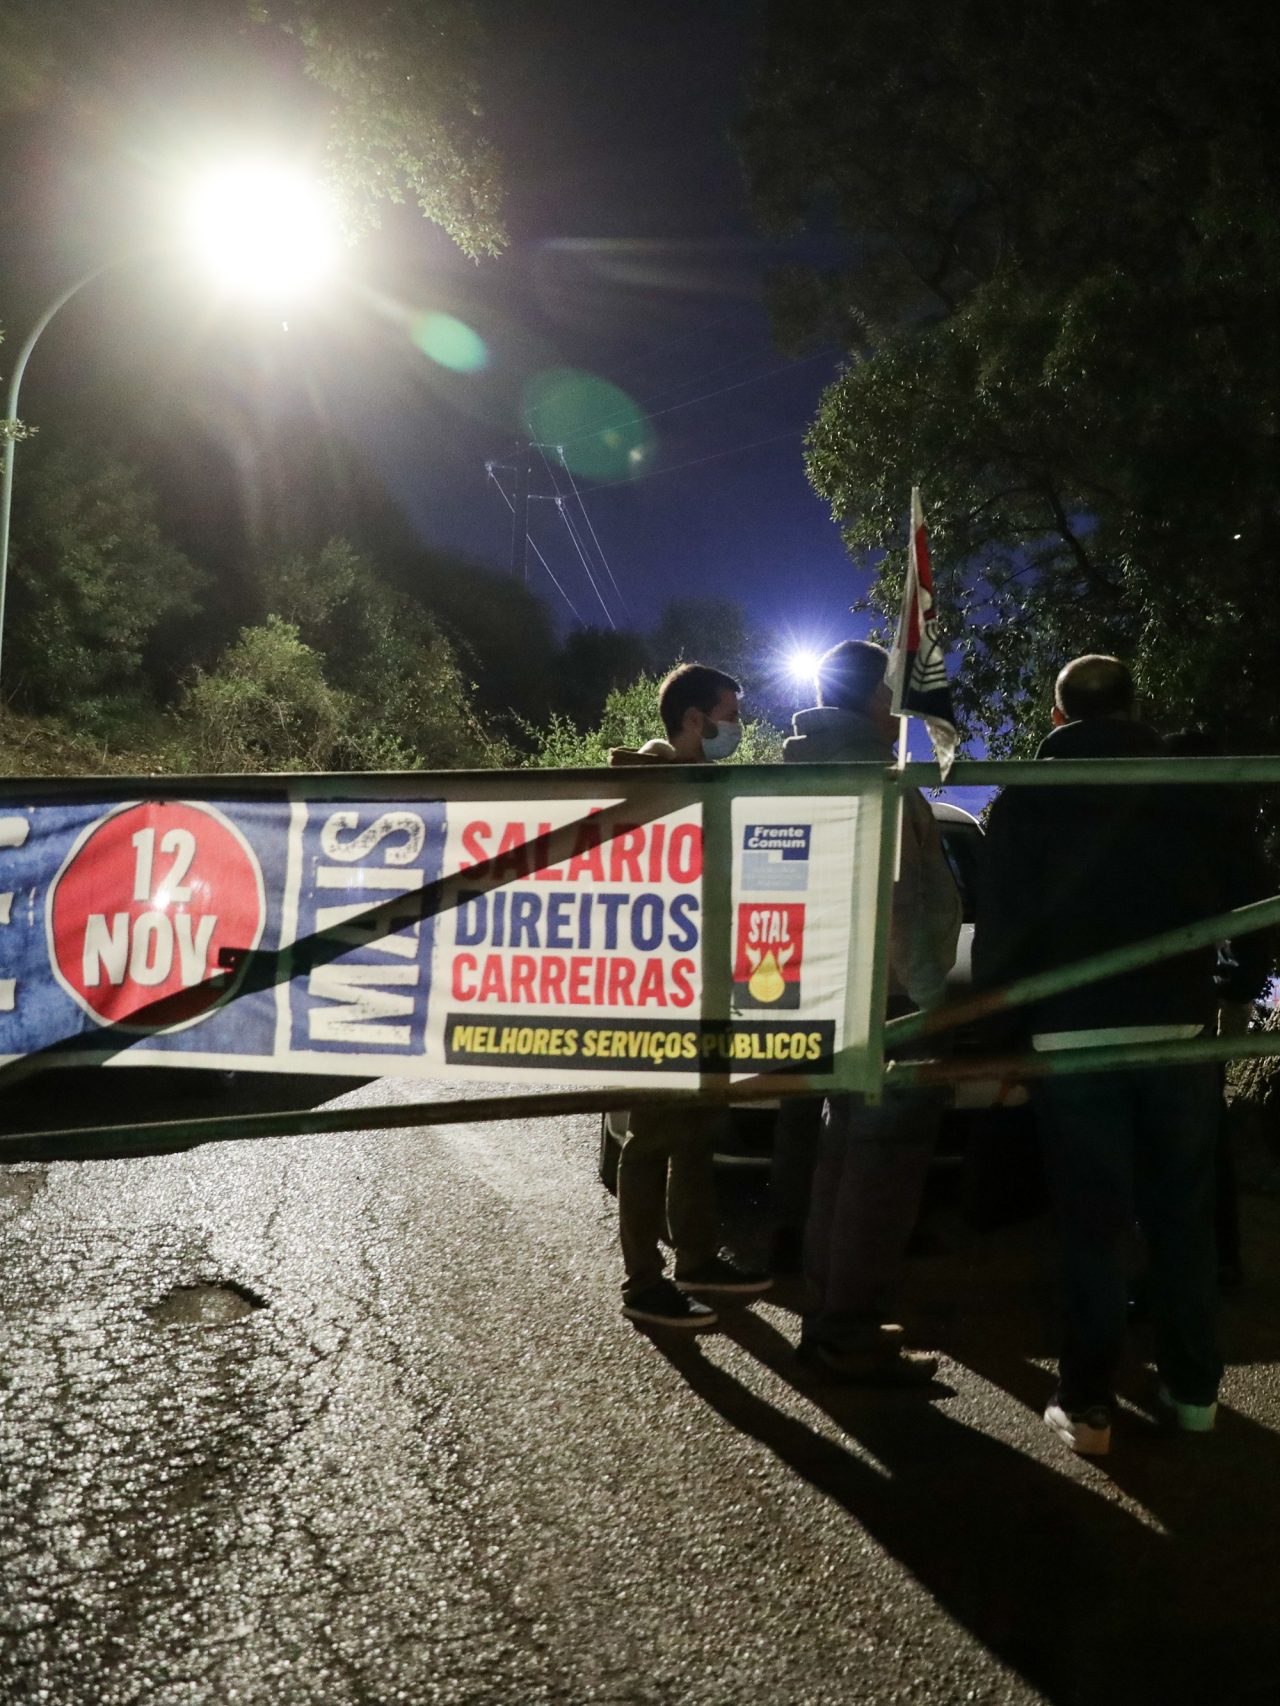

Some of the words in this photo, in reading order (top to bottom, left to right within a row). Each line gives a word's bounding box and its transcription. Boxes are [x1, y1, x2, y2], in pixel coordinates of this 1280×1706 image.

[459, 808, 704, 884] SALÁRIO
[748, 838, 806, 848] Comum
[754, 827, 804, 838] Frente
[131, 827, 196, 902] 12
[308, 811, 426, 1046] MAIS
[455, 889, 699, 952] DIREITOS
[748, 910, 790, 944] STAL
[451, 953, 696, 1008] CARREIRAS
[452, 1025, 578, 1055] MELHORES
[581, 1030, 697, 1065] SERVIÇOS
